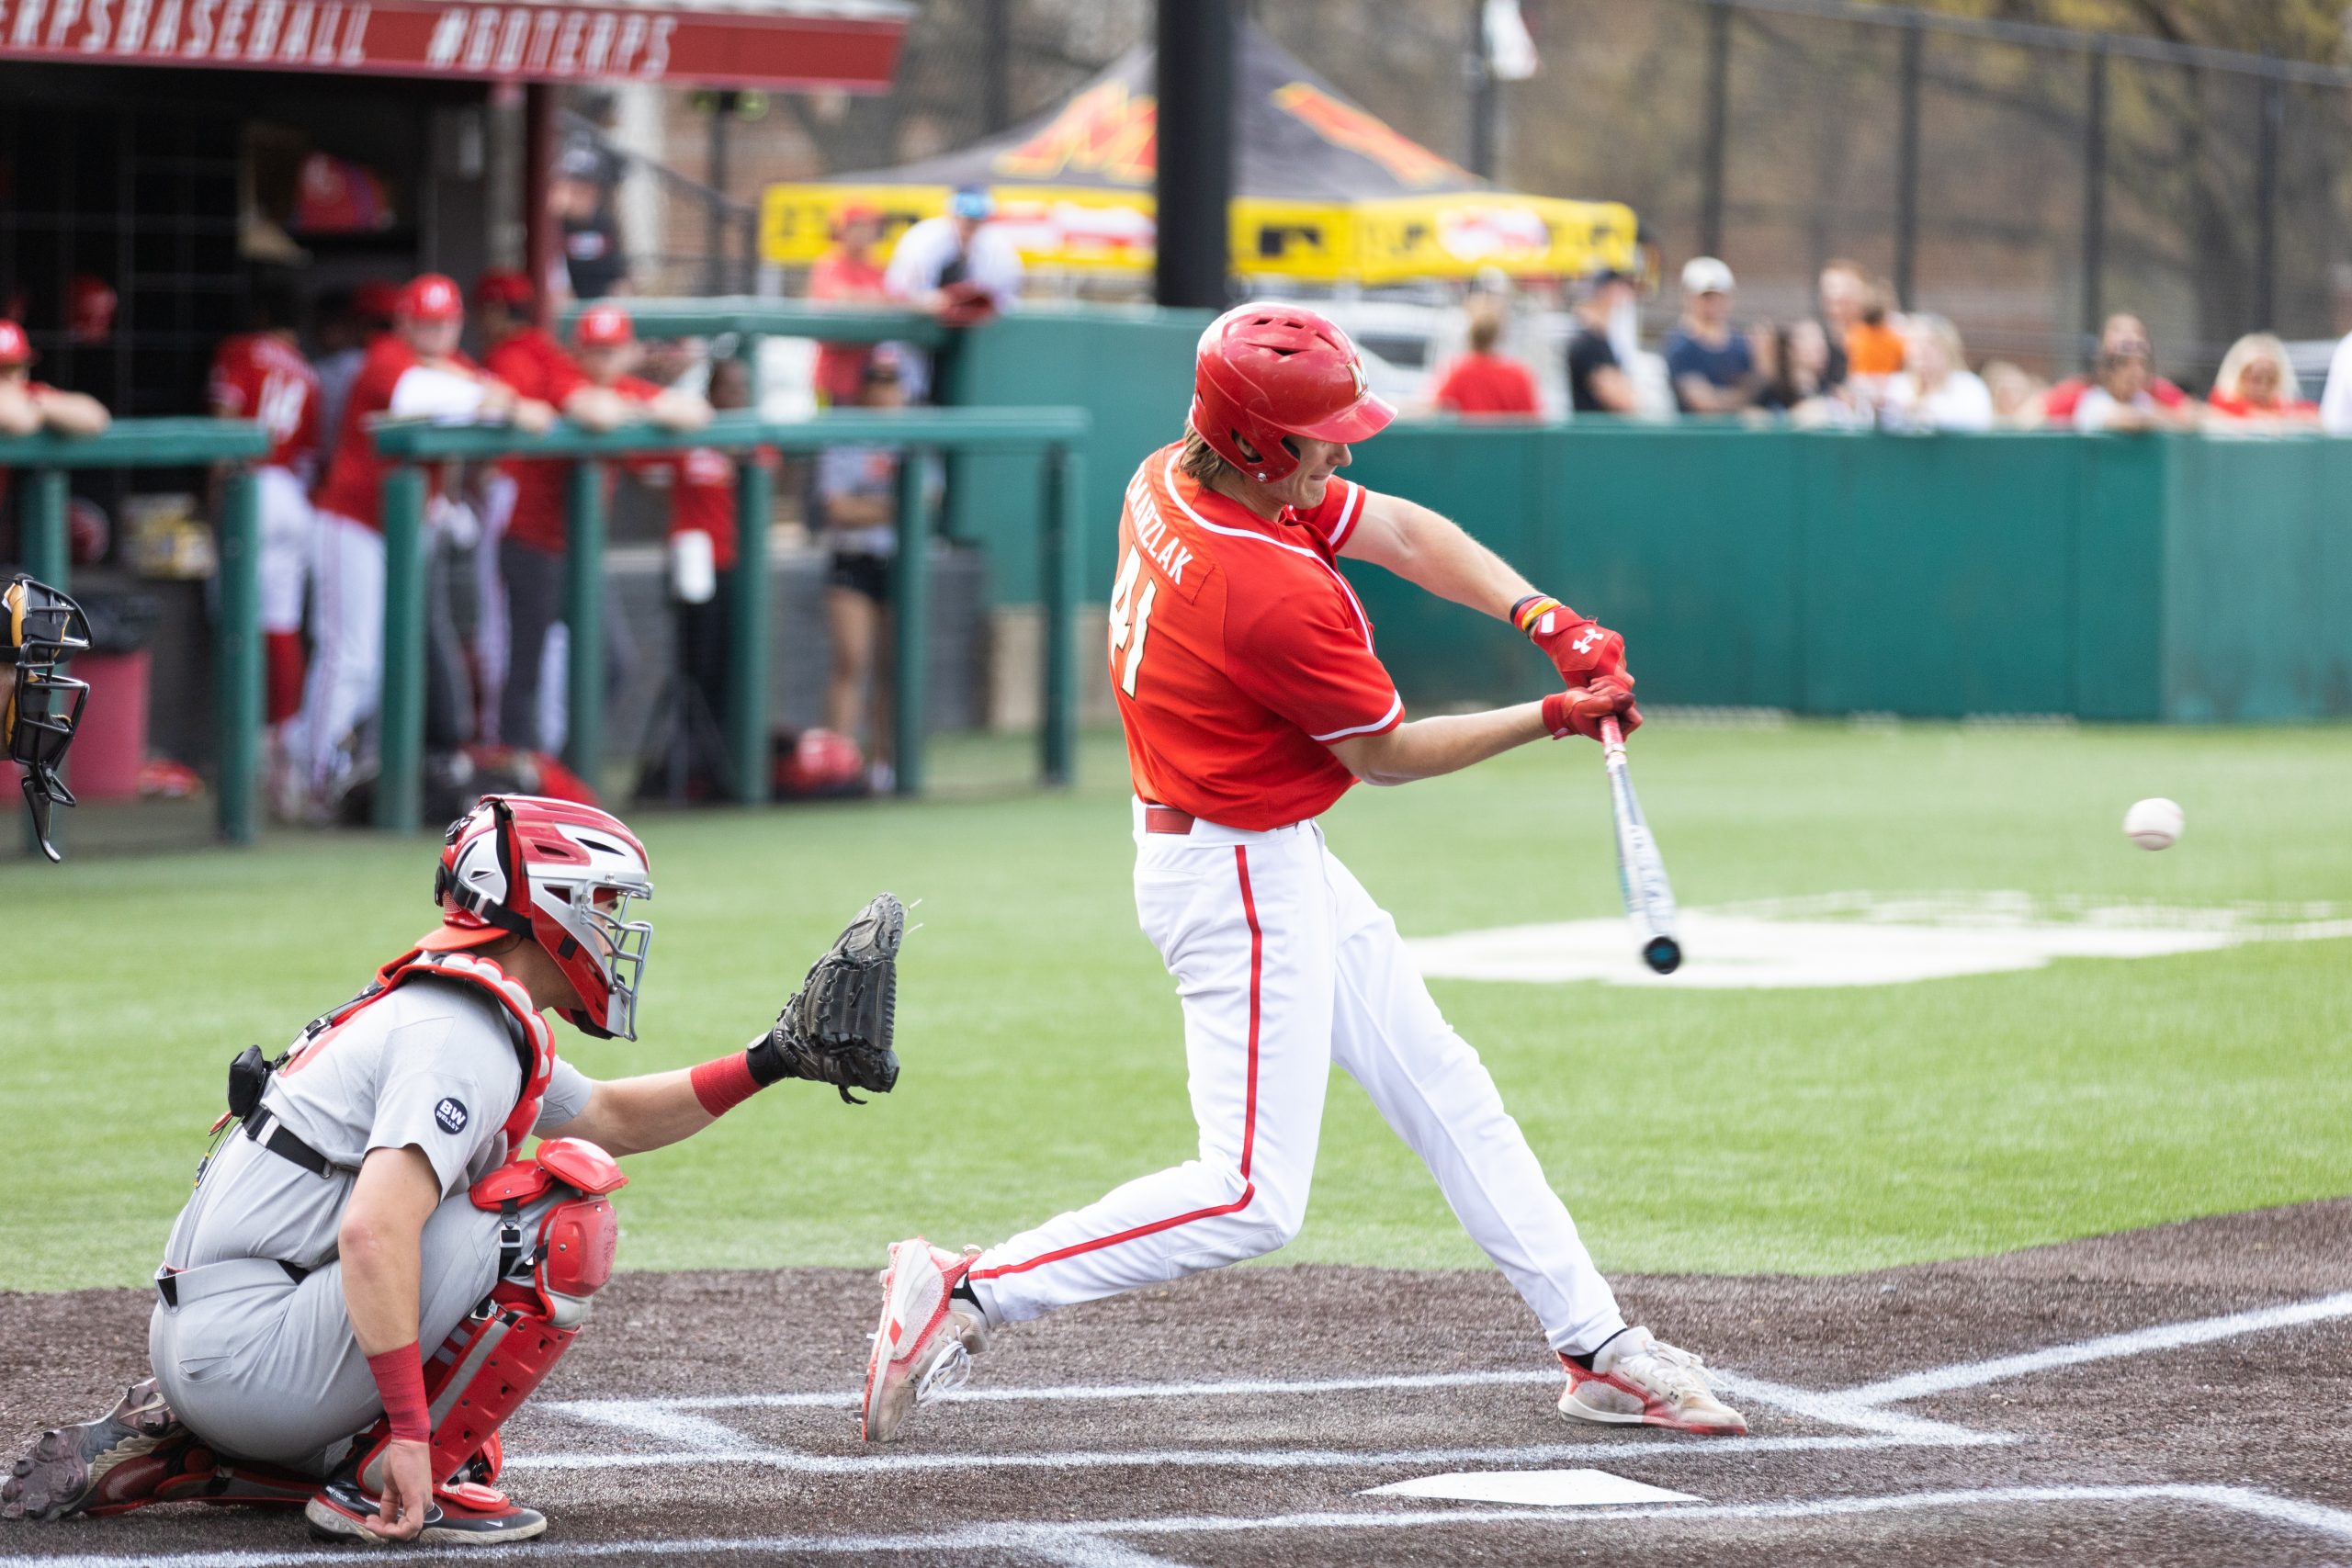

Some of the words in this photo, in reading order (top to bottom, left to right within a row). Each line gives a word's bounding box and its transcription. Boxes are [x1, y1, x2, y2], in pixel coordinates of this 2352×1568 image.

[425, 7, 678, 78] #GOTERPS
[1109, 542, 1157, 701] 41
[435, 1110, 459, 1132] WELLSY
[439, 1100, 466, 1125] BW
